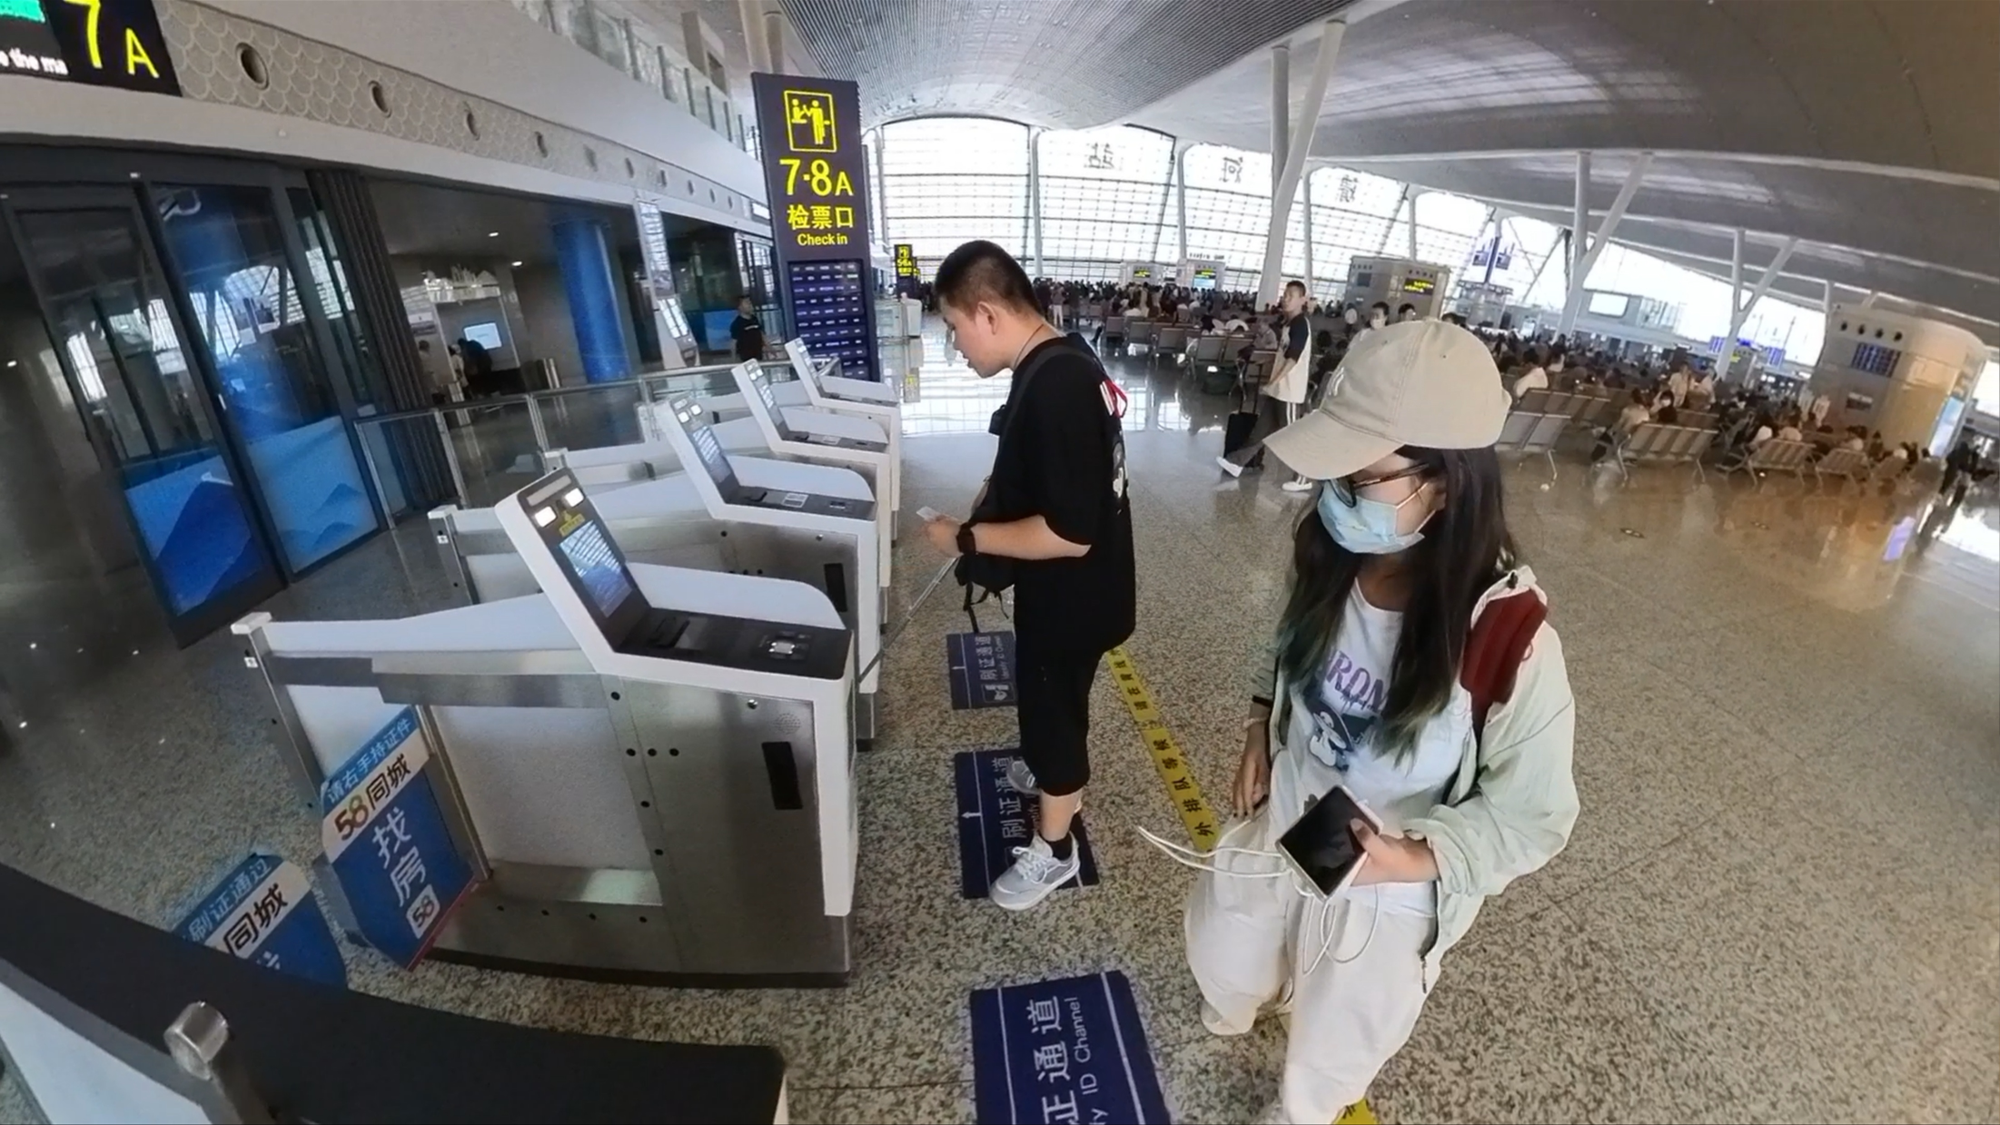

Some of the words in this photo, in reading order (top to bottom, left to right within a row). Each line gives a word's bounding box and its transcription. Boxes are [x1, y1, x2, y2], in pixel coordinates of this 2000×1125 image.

[787, 204, 854, 231] 检票口
[797, 233, 835, 247] Check
[837, 233, 848, 245] in
[327, 717, 413, 804] 请右手持证件
[333, 753, 412, 842] 58同城
[371, 806, 427, 907] 找房
[411, 894, 436, 929] 58
[1063, 996, 1092, 1064] Channel
[1079, 1072, 1099, 1096] ID
